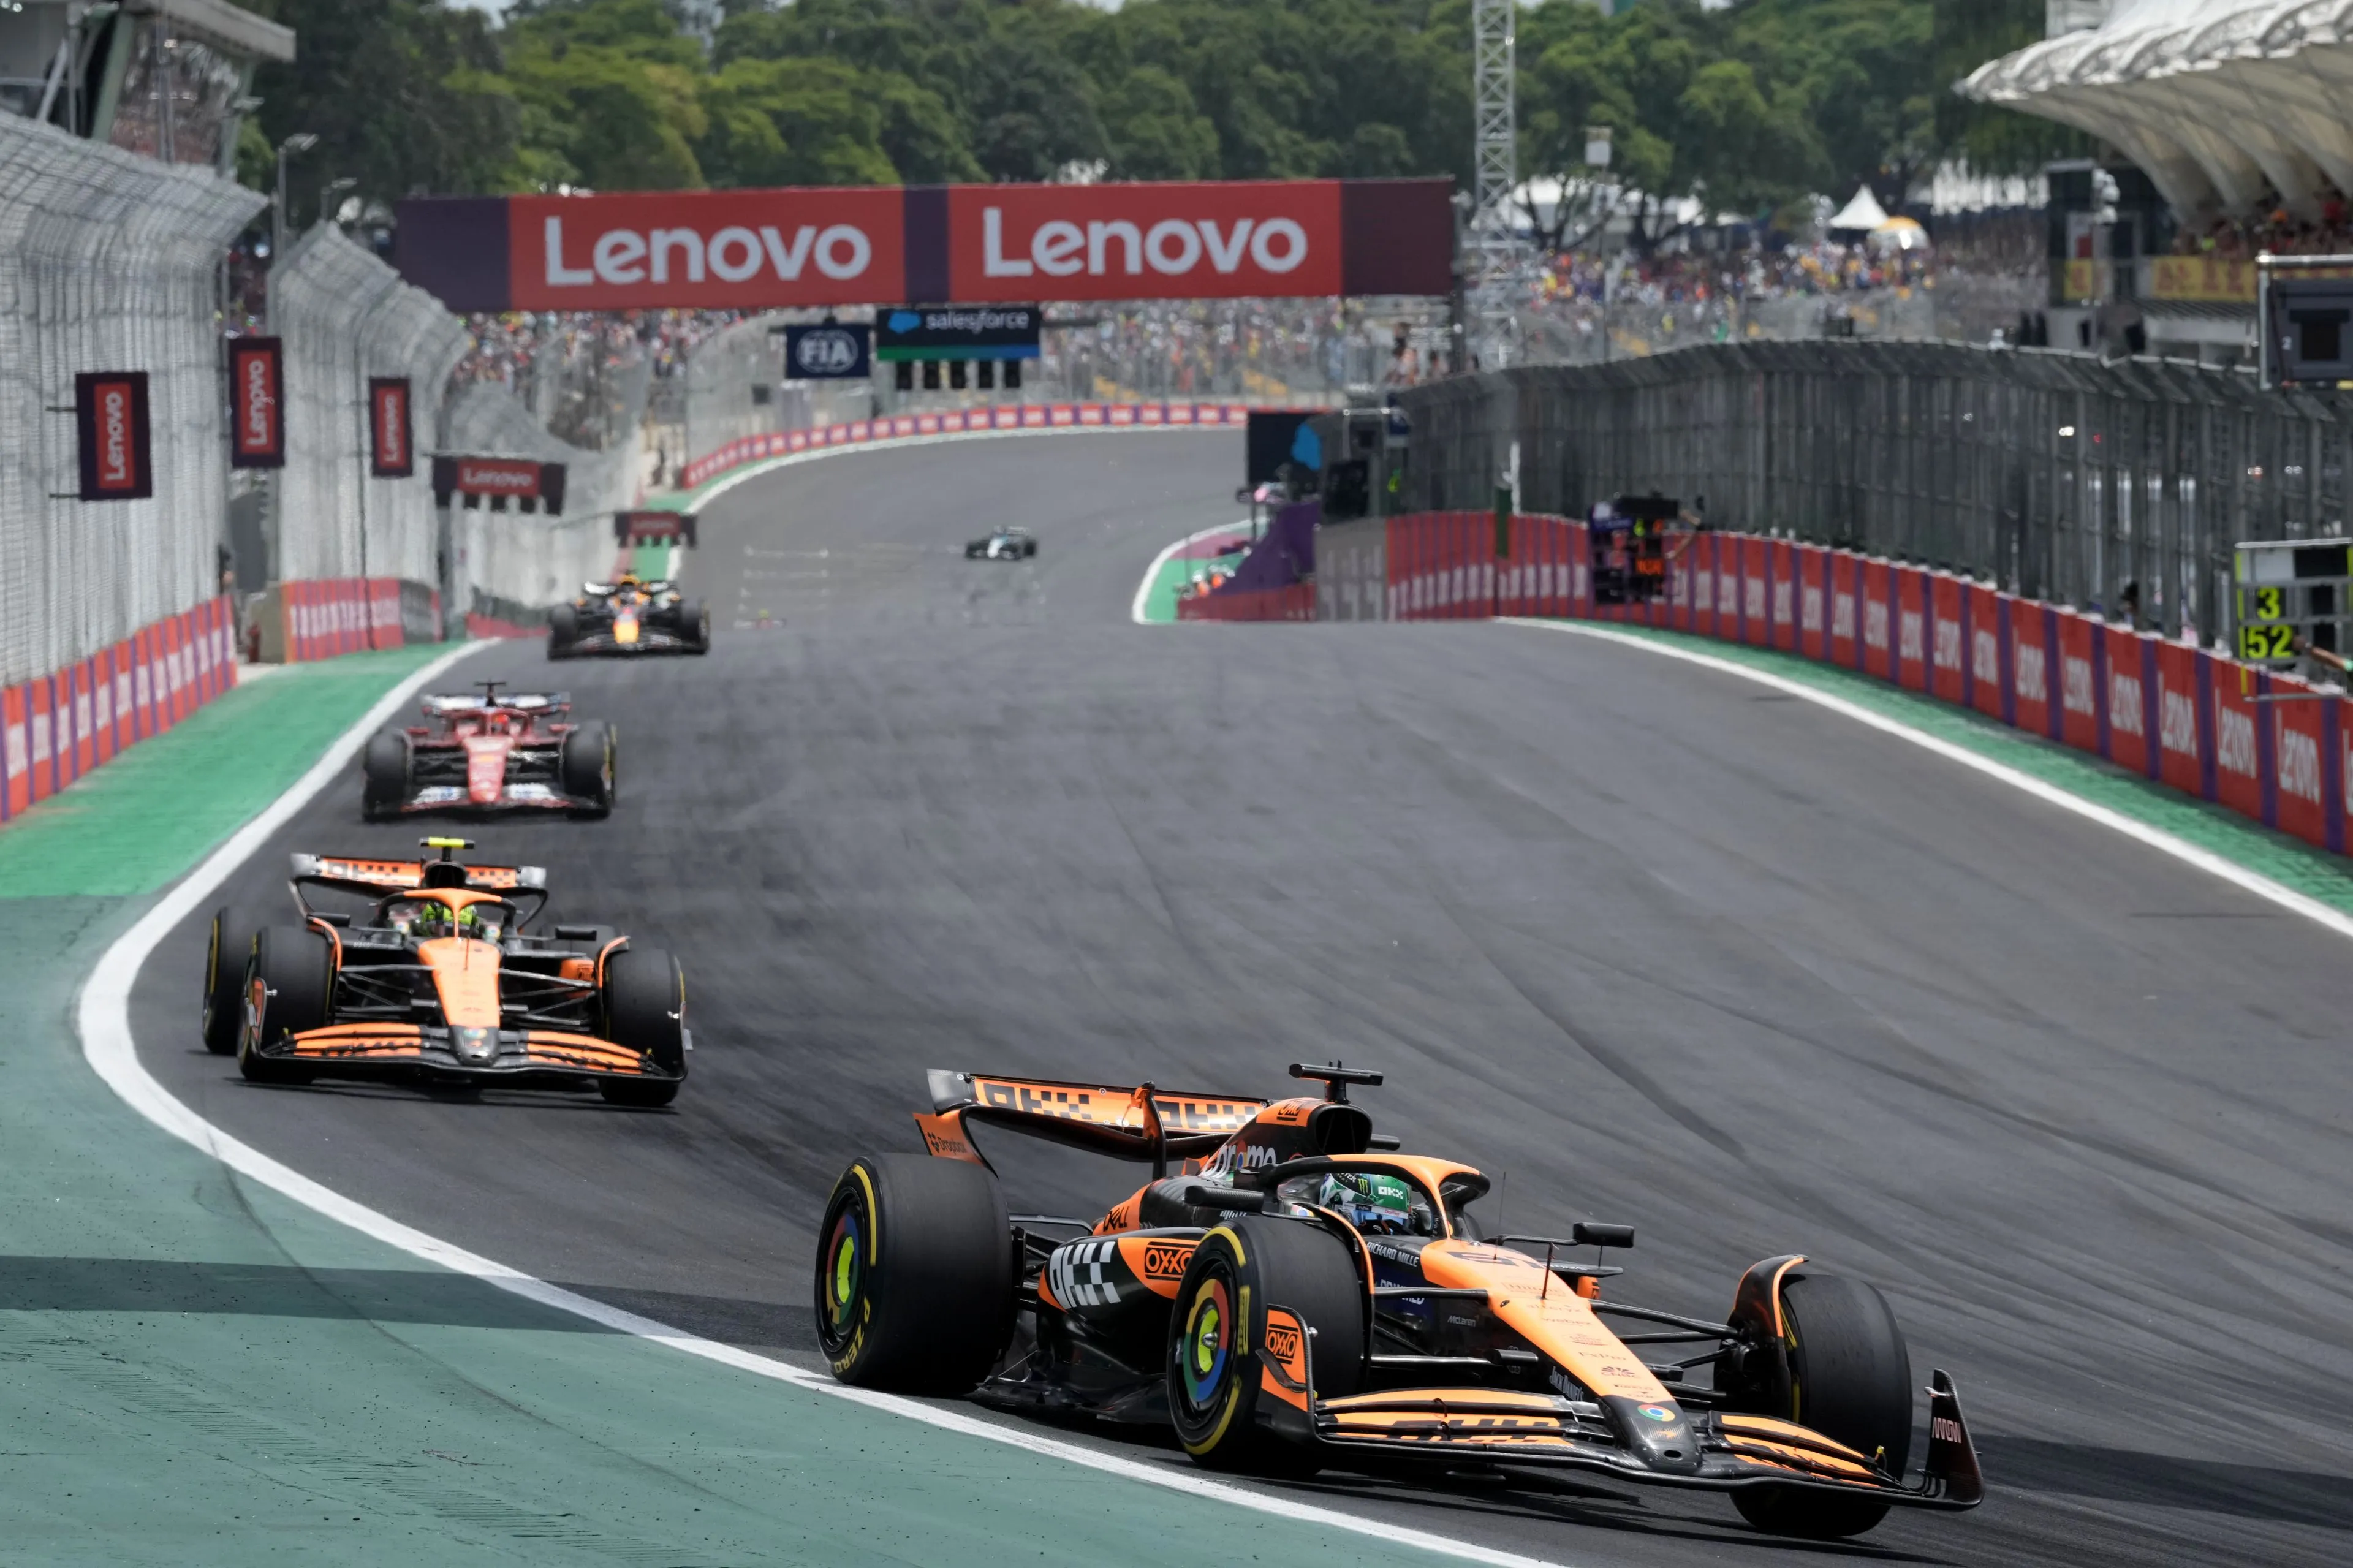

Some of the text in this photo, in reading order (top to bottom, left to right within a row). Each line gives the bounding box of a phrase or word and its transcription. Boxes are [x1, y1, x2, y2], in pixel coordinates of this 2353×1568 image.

[545, 215, 872, 286] Lenovo
[983, 206, 1308, 276] Lenovo
[926, 305, 1029, 334] salesforce
[246, 360, 268, 446] Lenovo
[105, 392, 126, 481] Lenovo
[463, 467, 532, 487] Lenovo
[2257, 586, 2280, 621] 3
[2246, 624, 2294, 659] 52
[939, 1137, 967, 1155] Dropbox
[1367, 1241, 1397, 1260] RICHARD
[1397, 1251, 1420, 1267] MILLE
[1447, 1315, 1476, 1328] McLaren
[1267, 1331, 1297, 1357] OXXO
